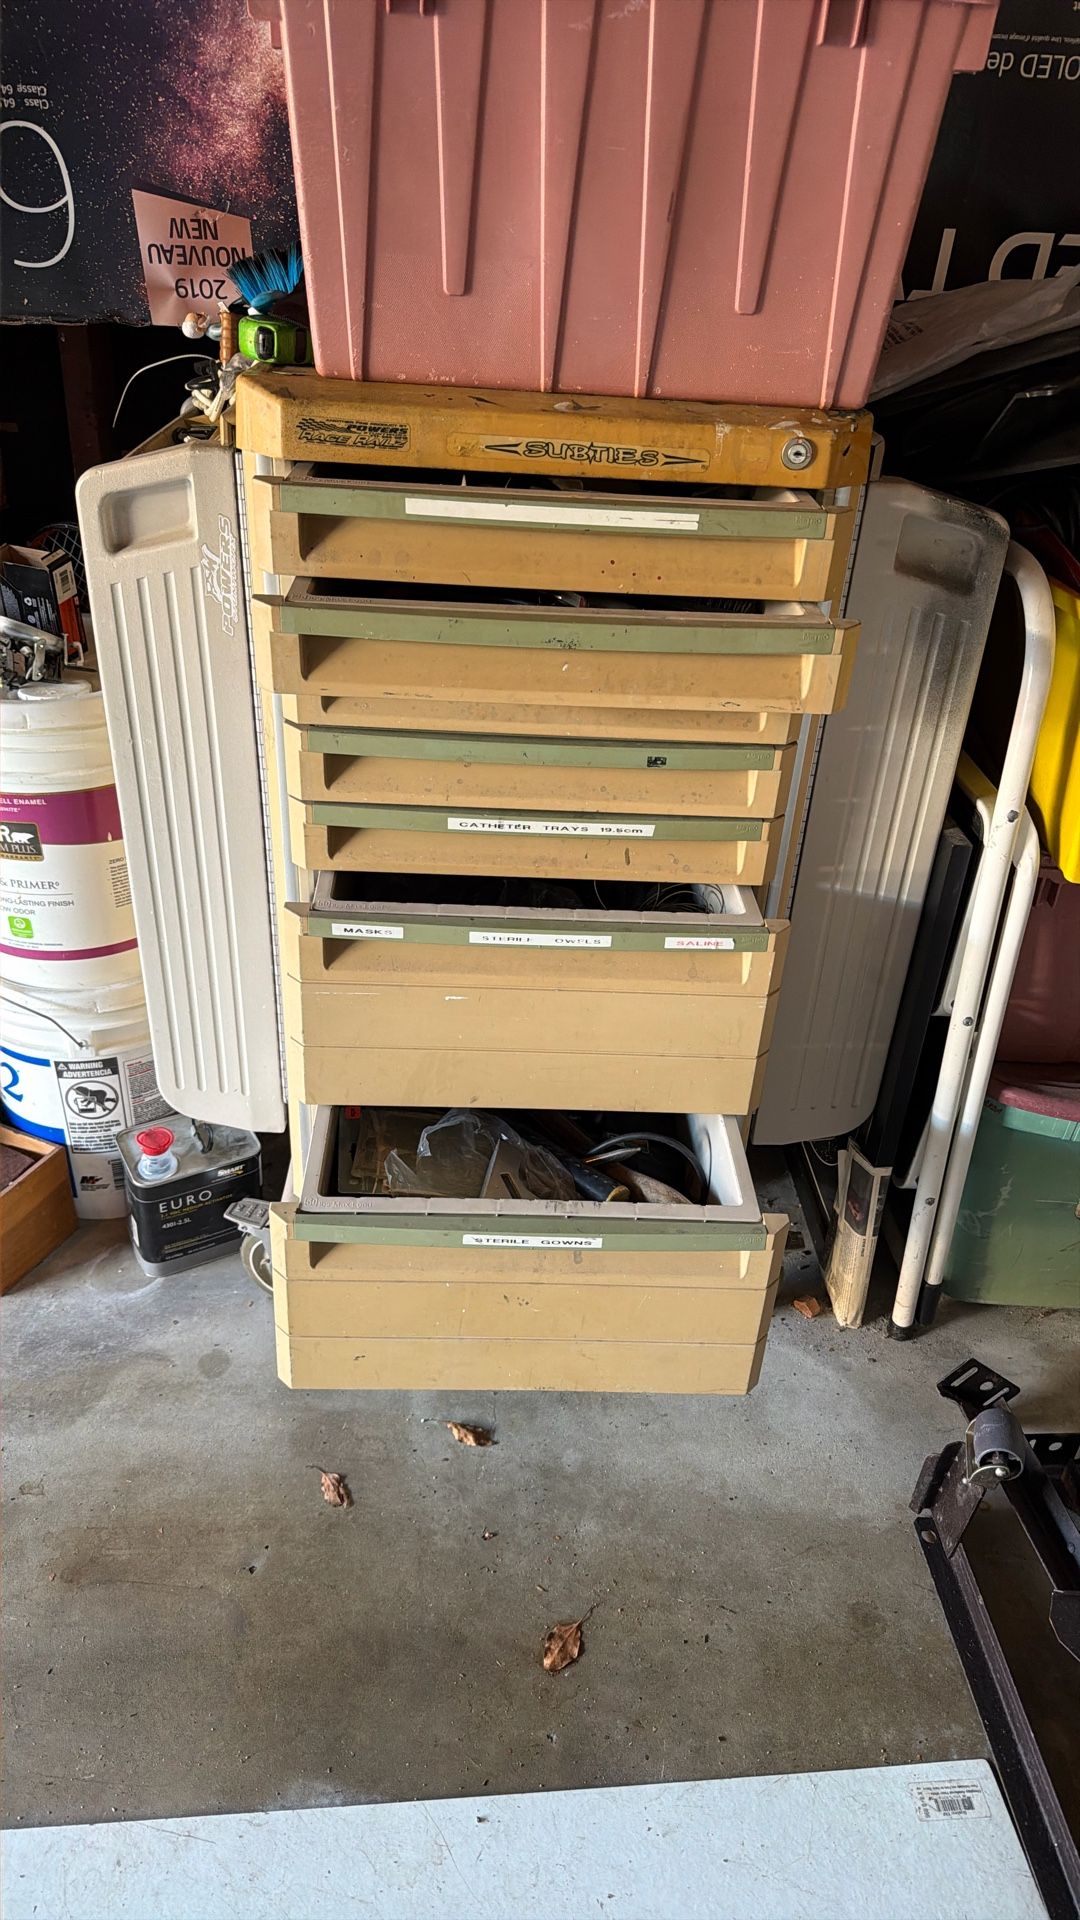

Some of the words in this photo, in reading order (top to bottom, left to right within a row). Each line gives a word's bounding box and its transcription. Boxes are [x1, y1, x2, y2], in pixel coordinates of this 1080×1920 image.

[987, 51, 1014, 78] de
[1020, 54, 1080, 80] OLED
[17, 84, 47, 97] Classe
[24, 98, 49, 110] Class
[169, 217, 219, 241] NEW
[148, 243, 246, 267] NOUVEAU
[174, 278, 228, 300] 2019
[347, 423, 409, 435] POWERS
[299, 430, 352, 445] RACE
[219, 514, 234, 636] POWERS
[13, 798, 47, 806] ENAMEL
[459, 821, 531, 831] CATHETER
[543, 825, 589, 833] TRAYS
[11, 844, 37, 854] PLUS
[344, 927, 393, 935] MASKS
[68, 1061, 104, 1070] WARNING
[63, 1068, 112, 1078] ADVERTENCIA
[217, 1164, 245, 1177] SMART
[159, 1190, 212, 1213] EURO
[474, 1237, 530, 1245] STERILE
